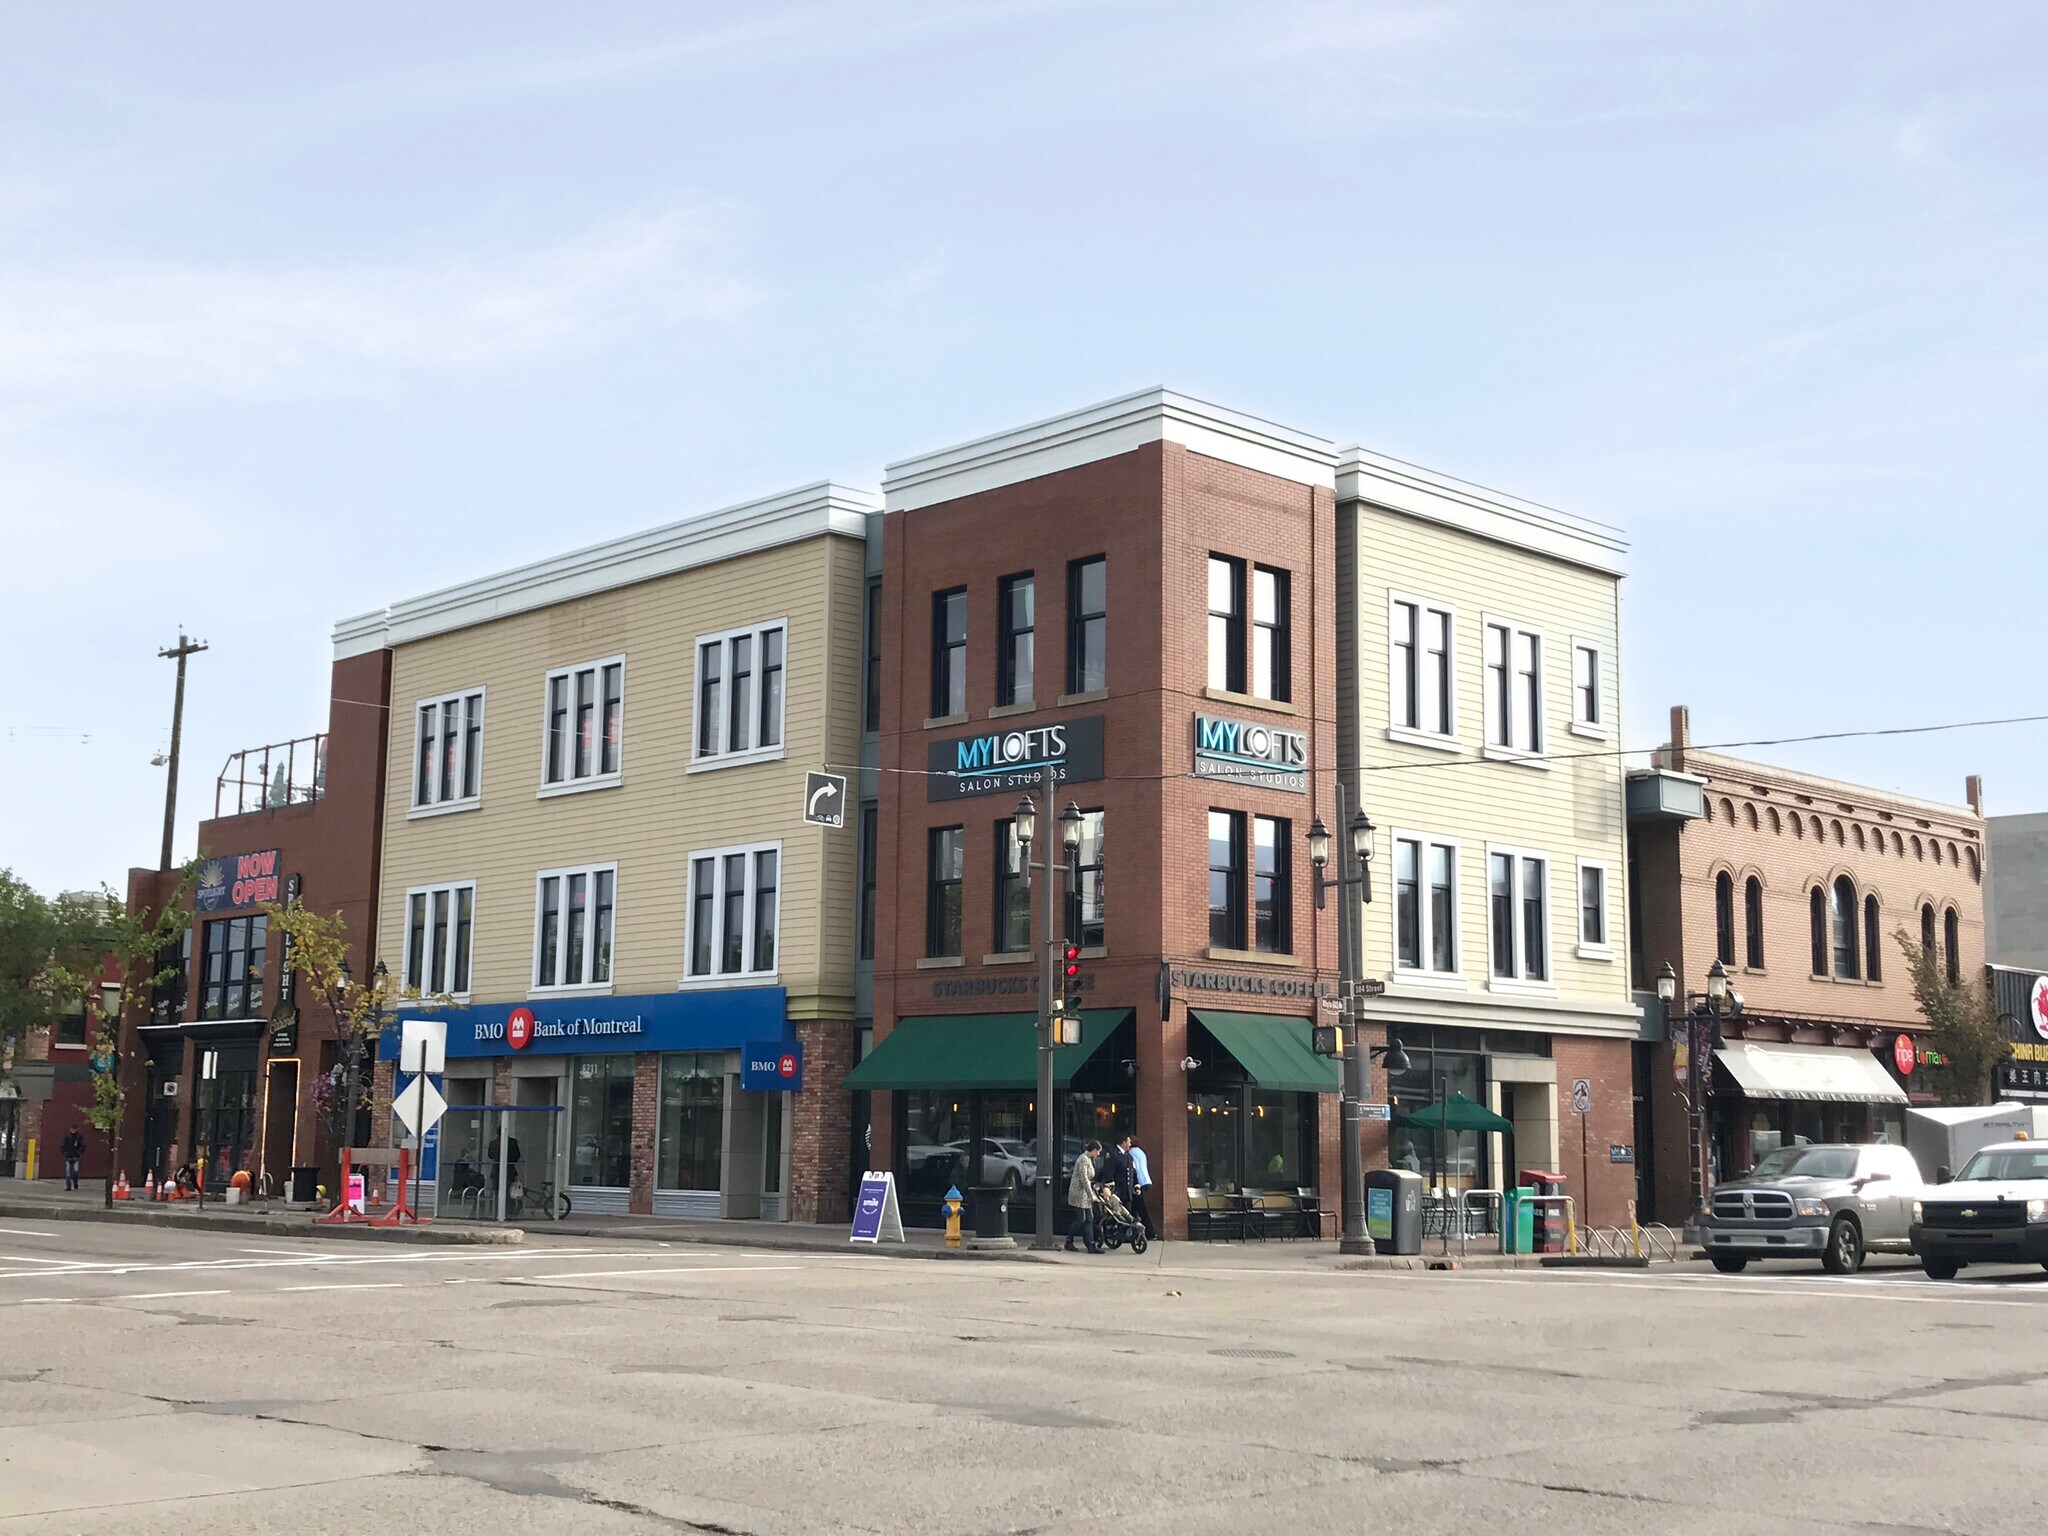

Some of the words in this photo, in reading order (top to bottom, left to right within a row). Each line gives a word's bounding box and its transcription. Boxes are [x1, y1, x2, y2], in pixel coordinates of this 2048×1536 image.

[958, 725, 1067, 769] MYLOFTS
[1198, 717, 1307, 766] MYLOFTS
[1008, 768, 1067, 786] STUDOS
[1200, 761, 1242, 779] SALON
[1250, 769, 1305, 789] STUDIOS
[960, 777, 1001, 793] SALON
[237, 850, 277, 879] NOW
[232, 876, 278, 905] OPEN
[933, 976, 1028, 997] STARBUCKS
[1171, 970, 1270, 993] STARBUCKS
[1273, 979, 1331, 997] COFFEE
[1366, 984, 1383, 993] Street
[474, 1022, 503, 1040] BMO
[533, 1018, 565, 1037] Bank
[567, 1017, 582, 1036] of
[583, 1015, 642, 1035] Montreal
[751, 1061, 776, 1072] BMO
